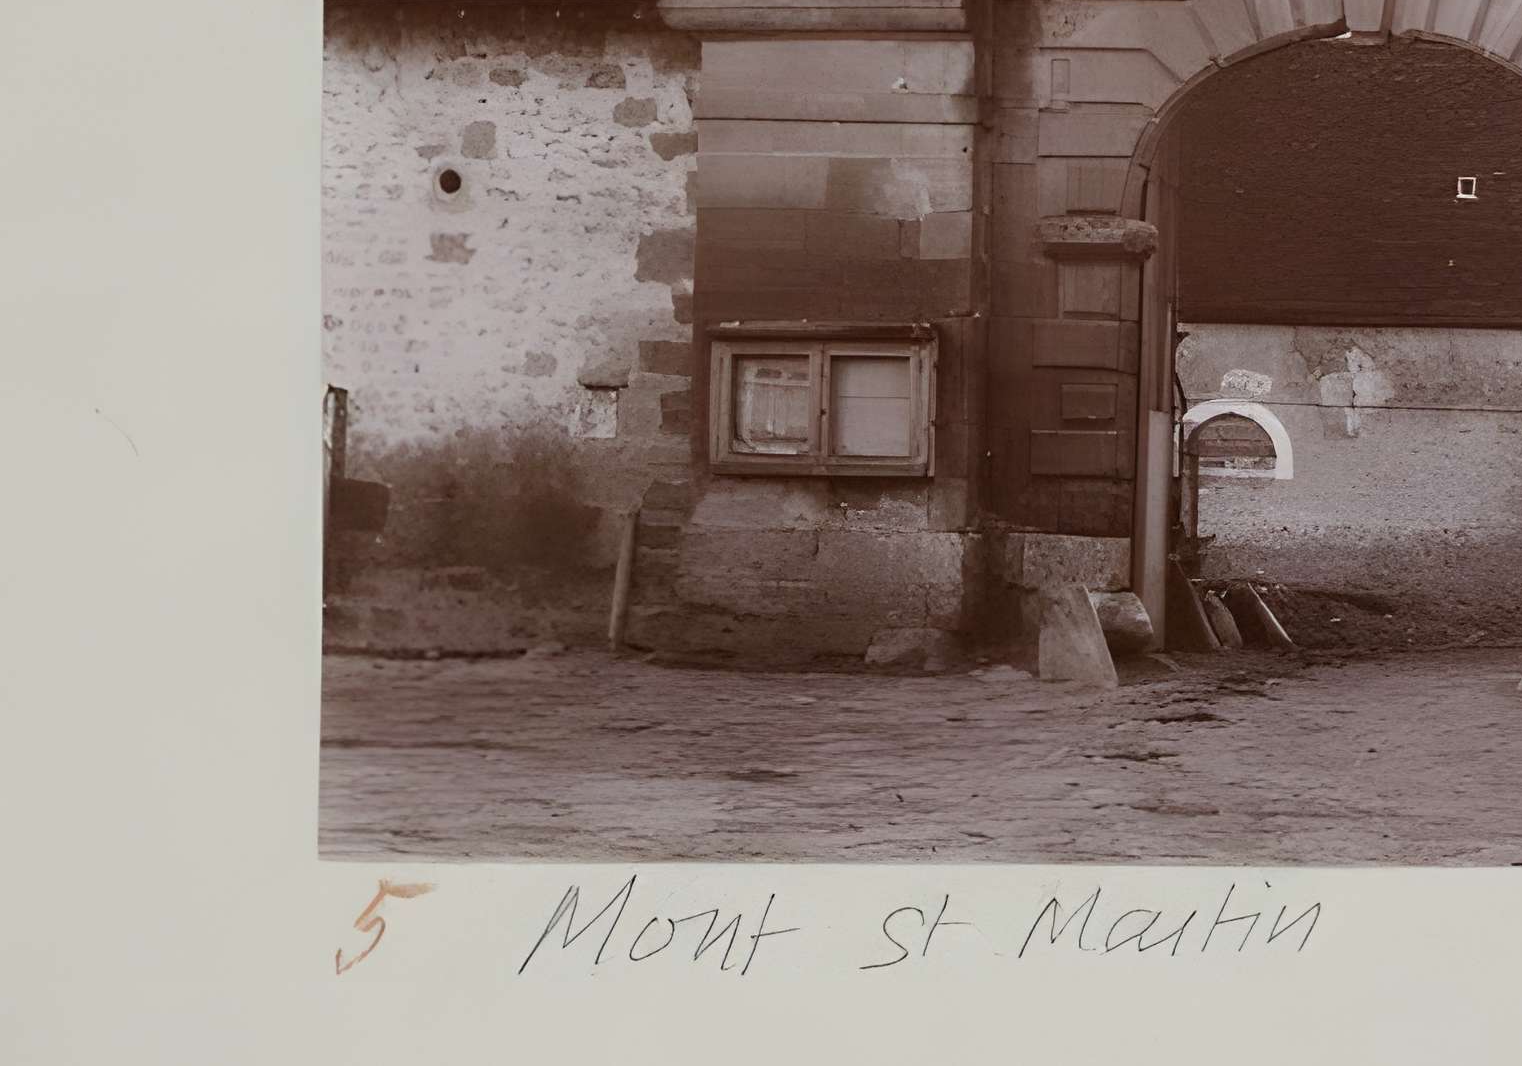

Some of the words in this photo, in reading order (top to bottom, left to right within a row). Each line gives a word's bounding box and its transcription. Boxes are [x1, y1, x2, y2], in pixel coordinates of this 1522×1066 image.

[335, 879, 434, 975] 5
[517, 874, 801, 976] Mont
[1018, 881, 1321, 958] Martin
